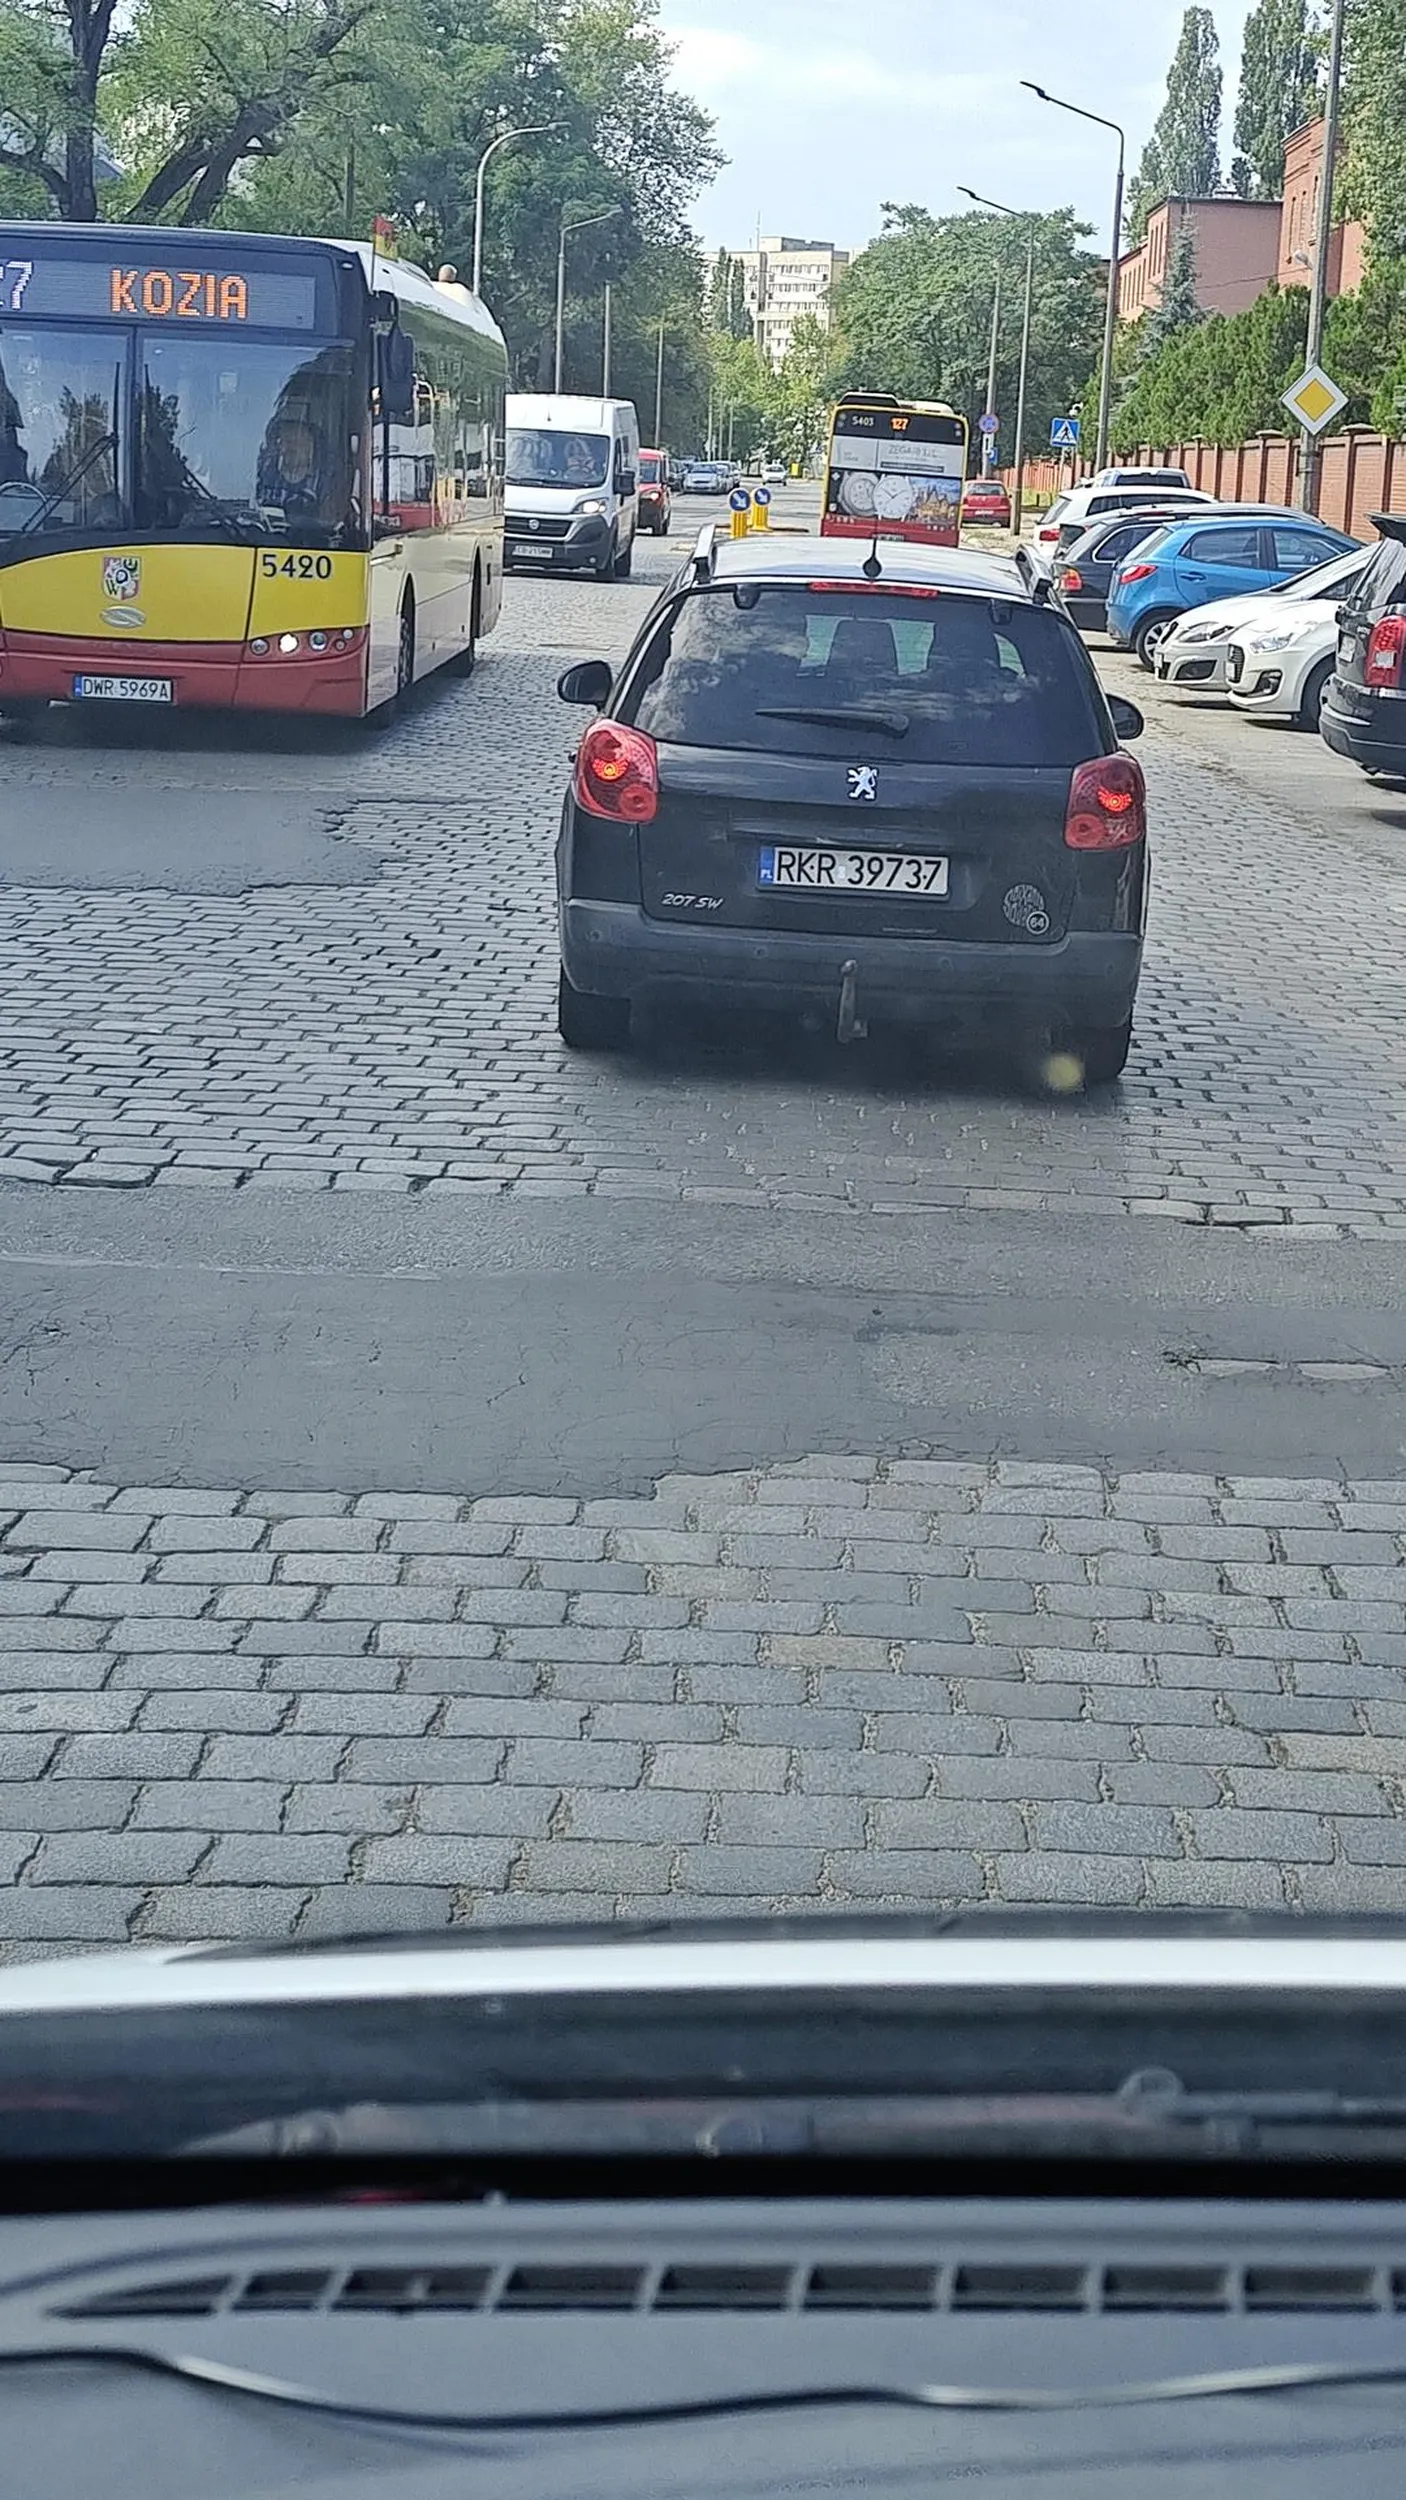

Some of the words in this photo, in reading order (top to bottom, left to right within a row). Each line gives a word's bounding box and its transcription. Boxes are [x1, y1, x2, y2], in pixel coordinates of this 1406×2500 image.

[0, 261, 33, 309] 7
[111, 269, 247, 318] KOZIA
[852, 415, 874, 426] 5403
[891, 417, 909, 430] 127
[262, 554, 332, 579] 5420
[83, 678, 114, 696] DWR
[119, 680, 169, 698] 5969A
[776, 850, 836, 884] RKR
[847, 855, 942, 890] 39737
[661, 893, 697, 907] 207
[694, 897, 724, 909] SW
